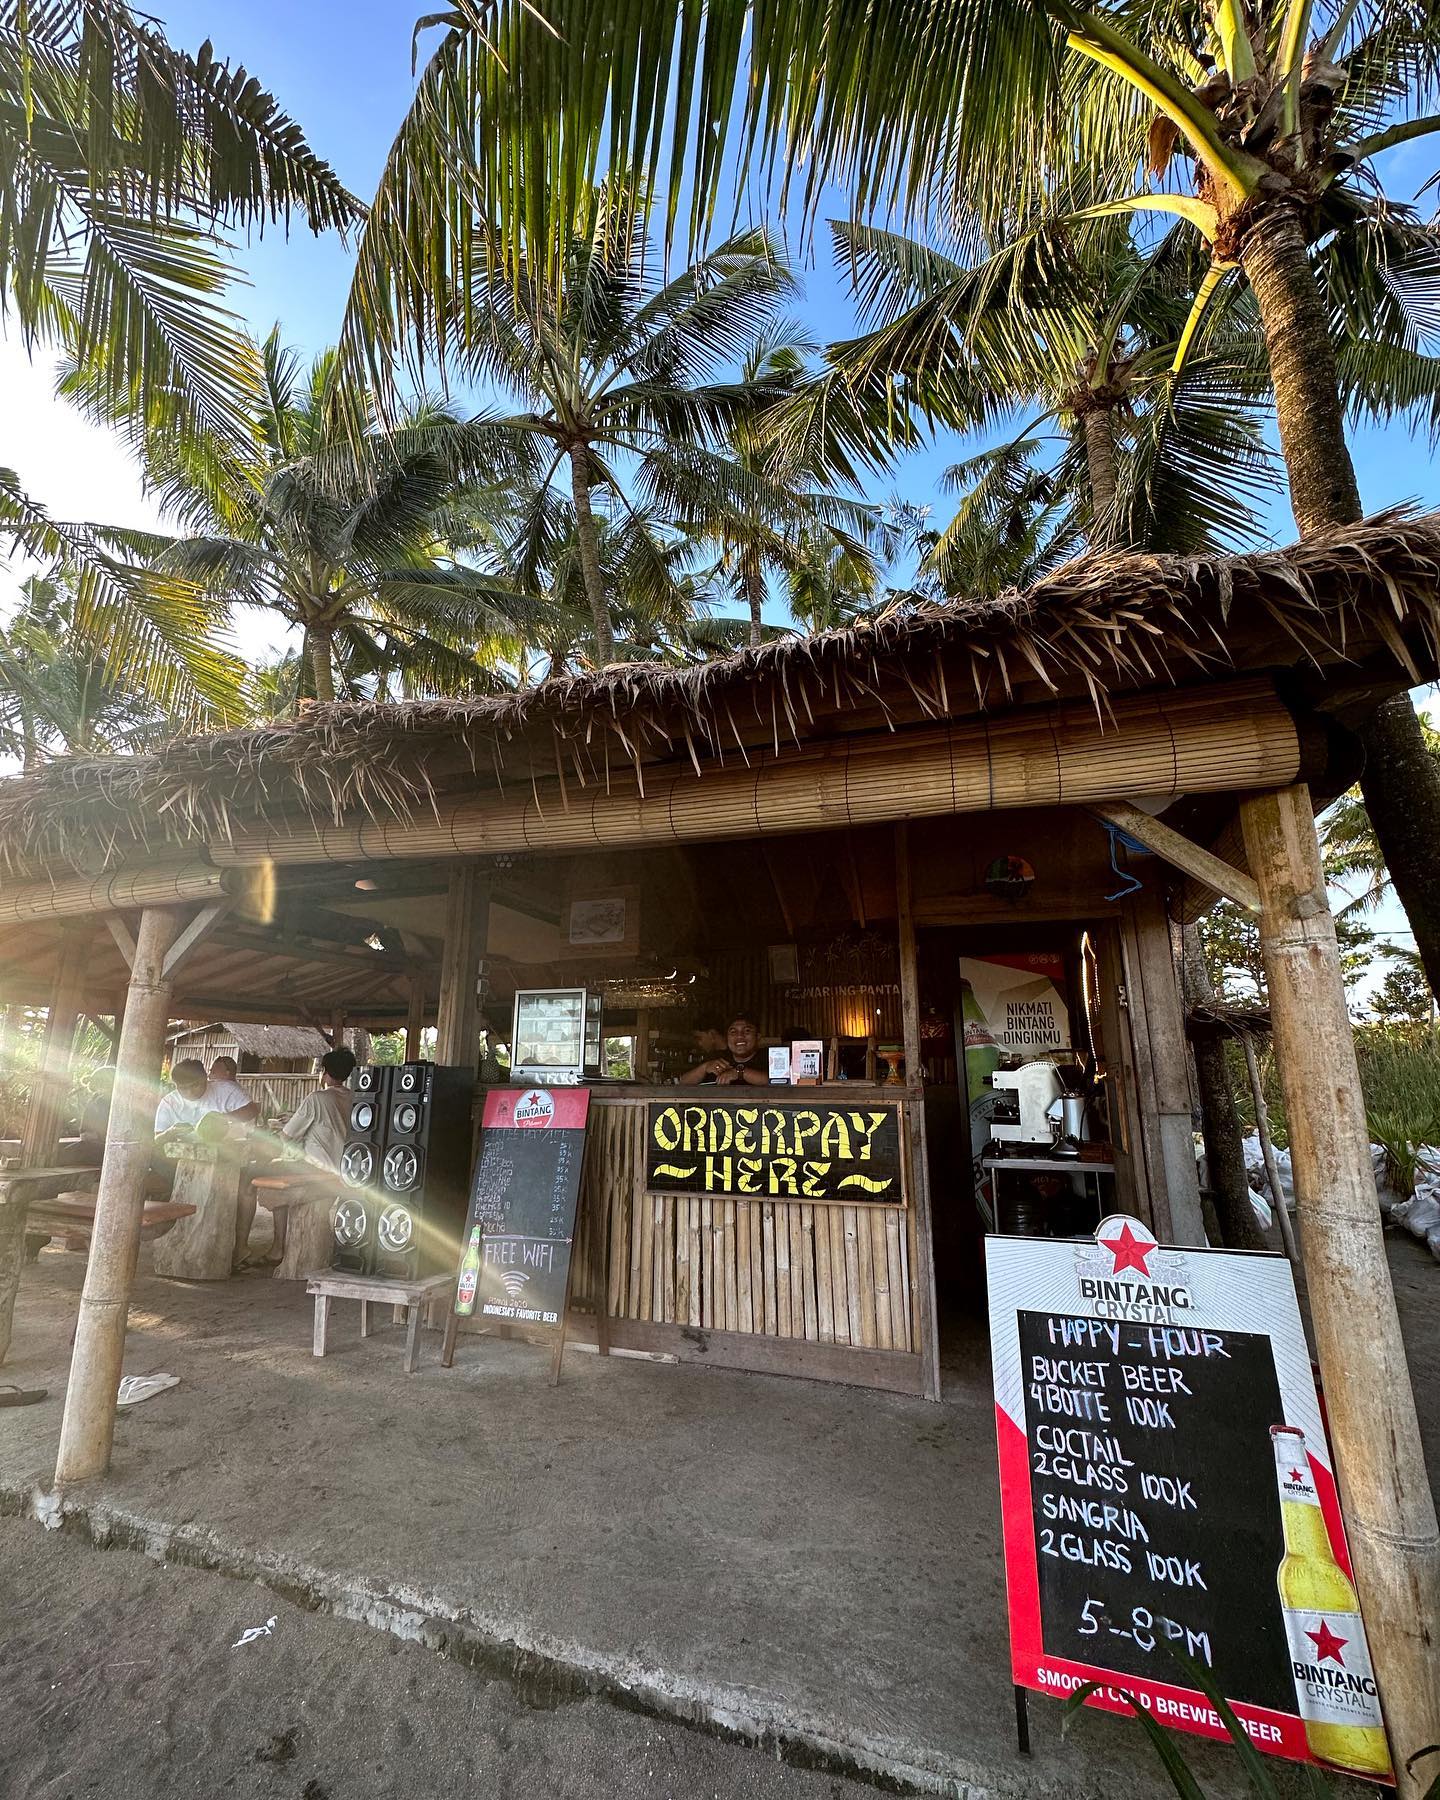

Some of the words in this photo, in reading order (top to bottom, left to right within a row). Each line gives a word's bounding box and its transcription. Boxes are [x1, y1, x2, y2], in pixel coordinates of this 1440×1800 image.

[859, 983, 900, 996] PANTA
[1006, 1002, 1053, 1016] NIKMATI
[1007, 1016, 1055, 1030] BINTANG
[1003, 1031, 1061, 1045] DINGINMU
[517, 1106, 551, 1118] BINTANG
[705, 1156, 831, 1198] HERE
[484, 1242, 516, 1267] FREE
[523, 1244, 553, 1273] WIFI
[516, 1308, 541, 1321] FAVORITE
[543, 1312, 558, 1323] BEER
[1094, 1299, 1179, 1326] CRYSTAL
[1048, 1317, 1120, 1356] HAPPY
[1148, 1326, 1232, 1361] HOUR
[1032, 1355, 1110, 1388] BUCKET
[1120, 1364, 1193, 1396] BEER
[1125, 1396, 1176, 1429] 100K
[1140, 1471, 1198, 1510] 100K
[1042, 1493, 1150, 1544] SANGRIA
[1145, 1550, 1208, 1592] 100K
[1293, 1661, 1377, 1697] BINTANG
[1306, 1683, 1371, 1710] CRYSTAL
[1156, 1697, 1227, 1729] BREWE
